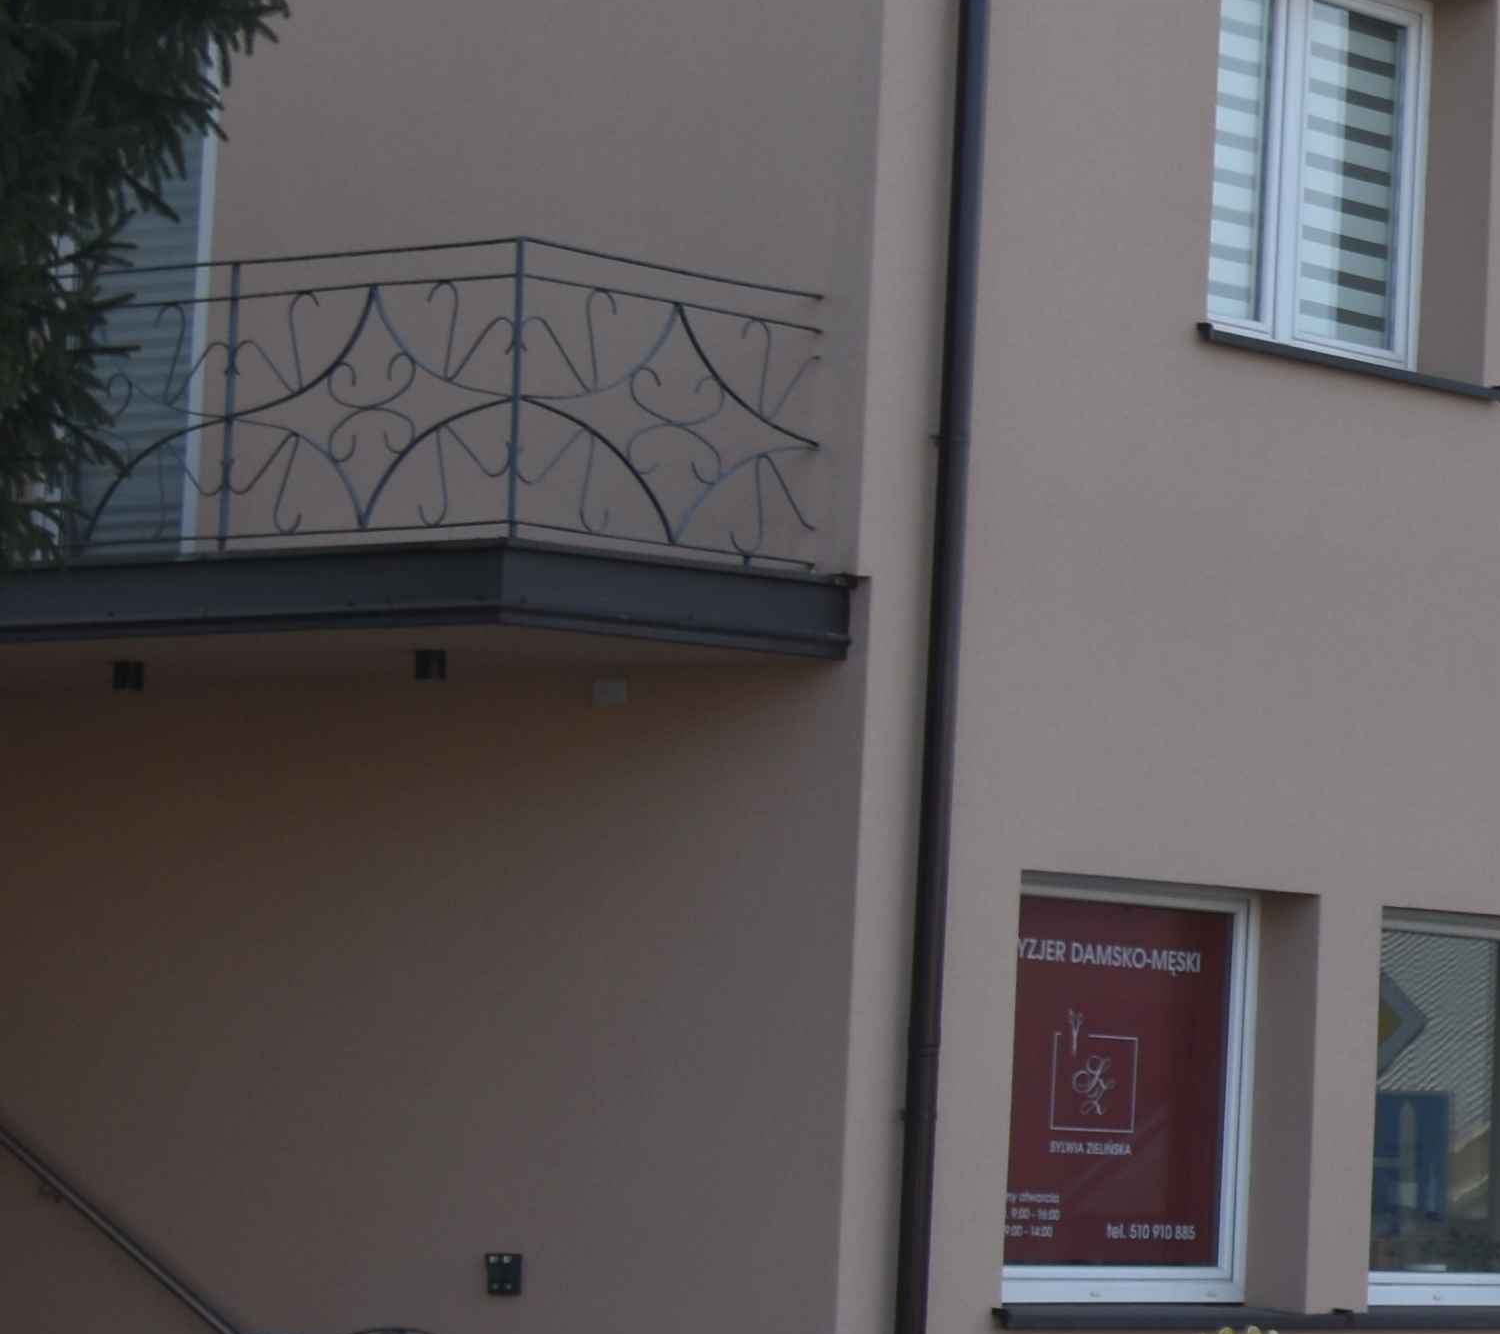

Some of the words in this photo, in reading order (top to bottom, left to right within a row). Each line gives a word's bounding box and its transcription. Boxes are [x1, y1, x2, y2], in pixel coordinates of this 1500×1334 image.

[1070, 942, 1201, 977] DAMSKO-MĘSKI
[1049, 1139, 1085, 1154] SYLWIA
[1130, 1224, 1150, 1240] 510
[1152, 1224, 1172, 1241] 910
